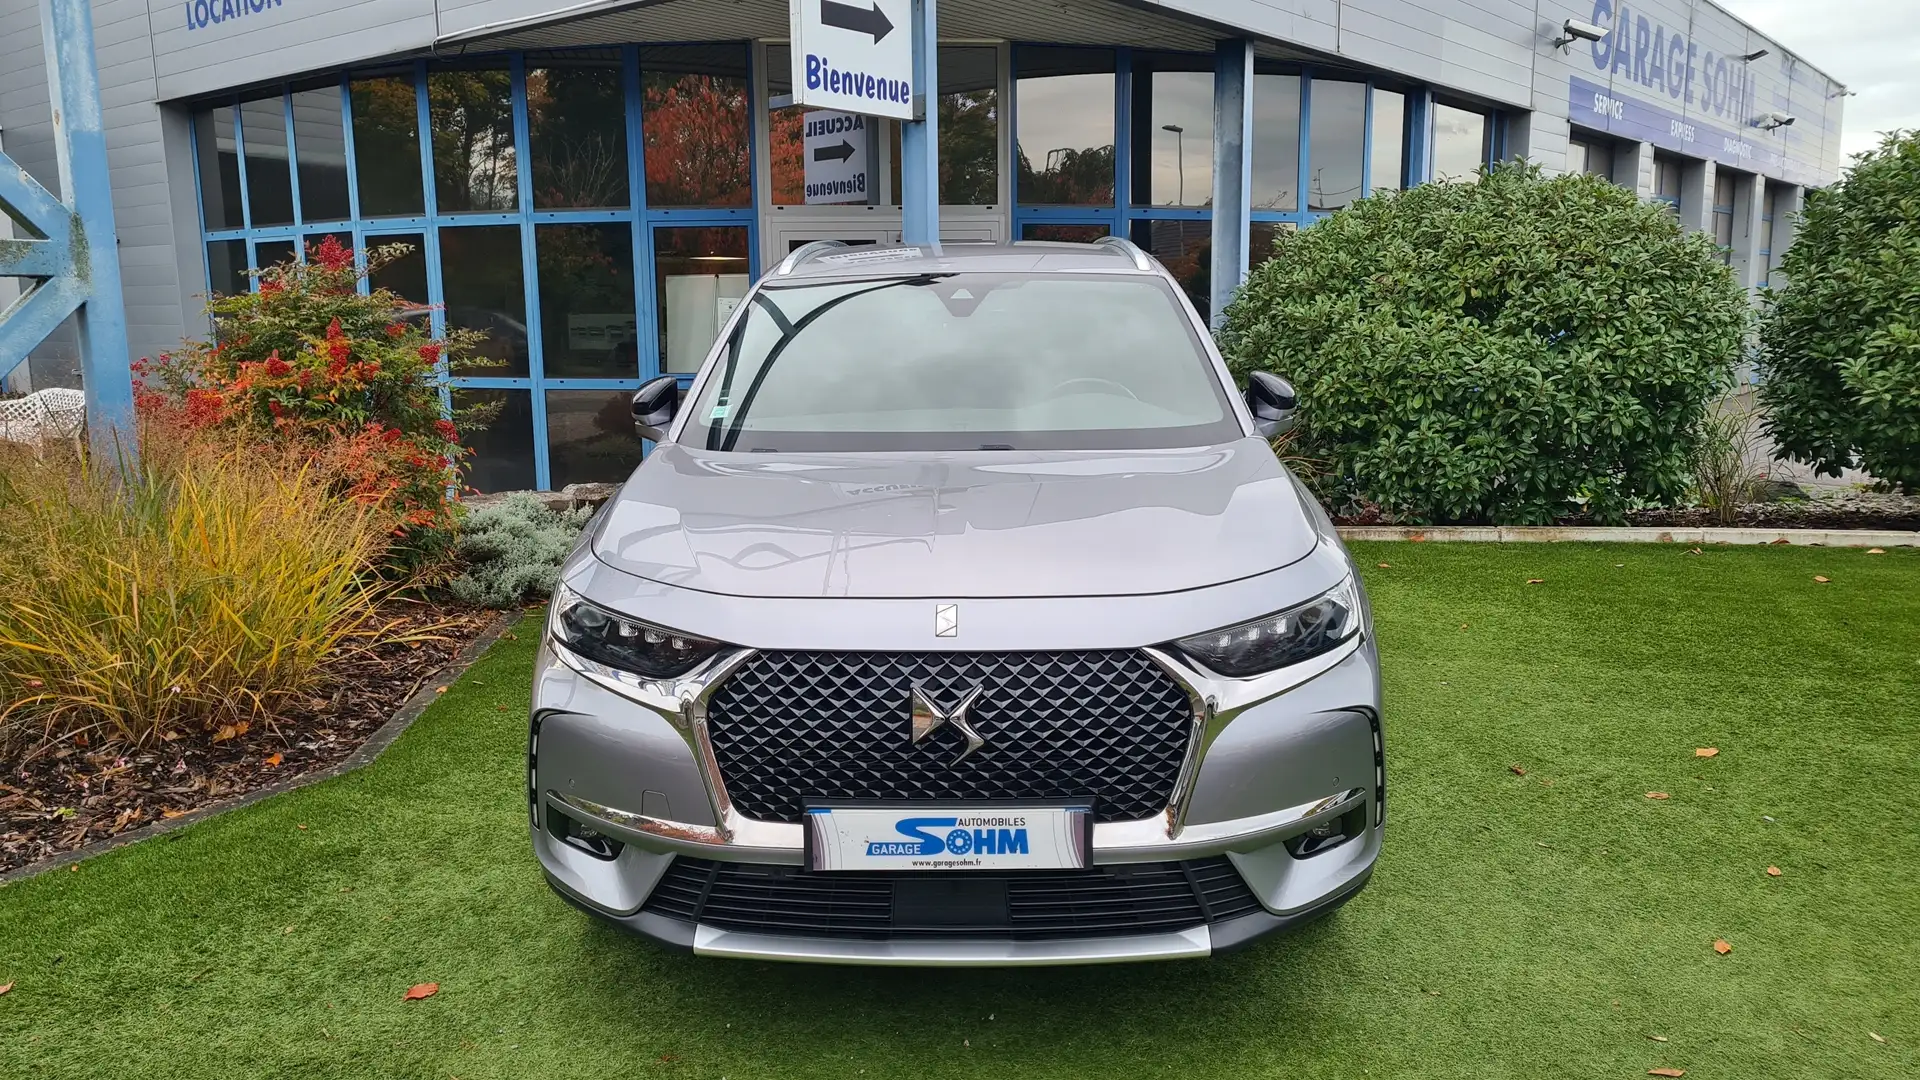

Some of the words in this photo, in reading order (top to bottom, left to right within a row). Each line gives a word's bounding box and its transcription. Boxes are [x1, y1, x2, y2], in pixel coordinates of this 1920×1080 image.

[186, 0, 282, 30] LOCATI
[1591, 0, 1697, 104] GARAGE
[805, 54, 910, 105] Bienvenue
[1594, 92, 1624, 120] SERVICE
[1671, 119, 1695, 142] EXPRESS
[958, 817, 1026, 827] AUTOMOBILES
[871, 844, 921, 855] GARAGE
[912, 858, 982, 868] www.garagesohm.fr
